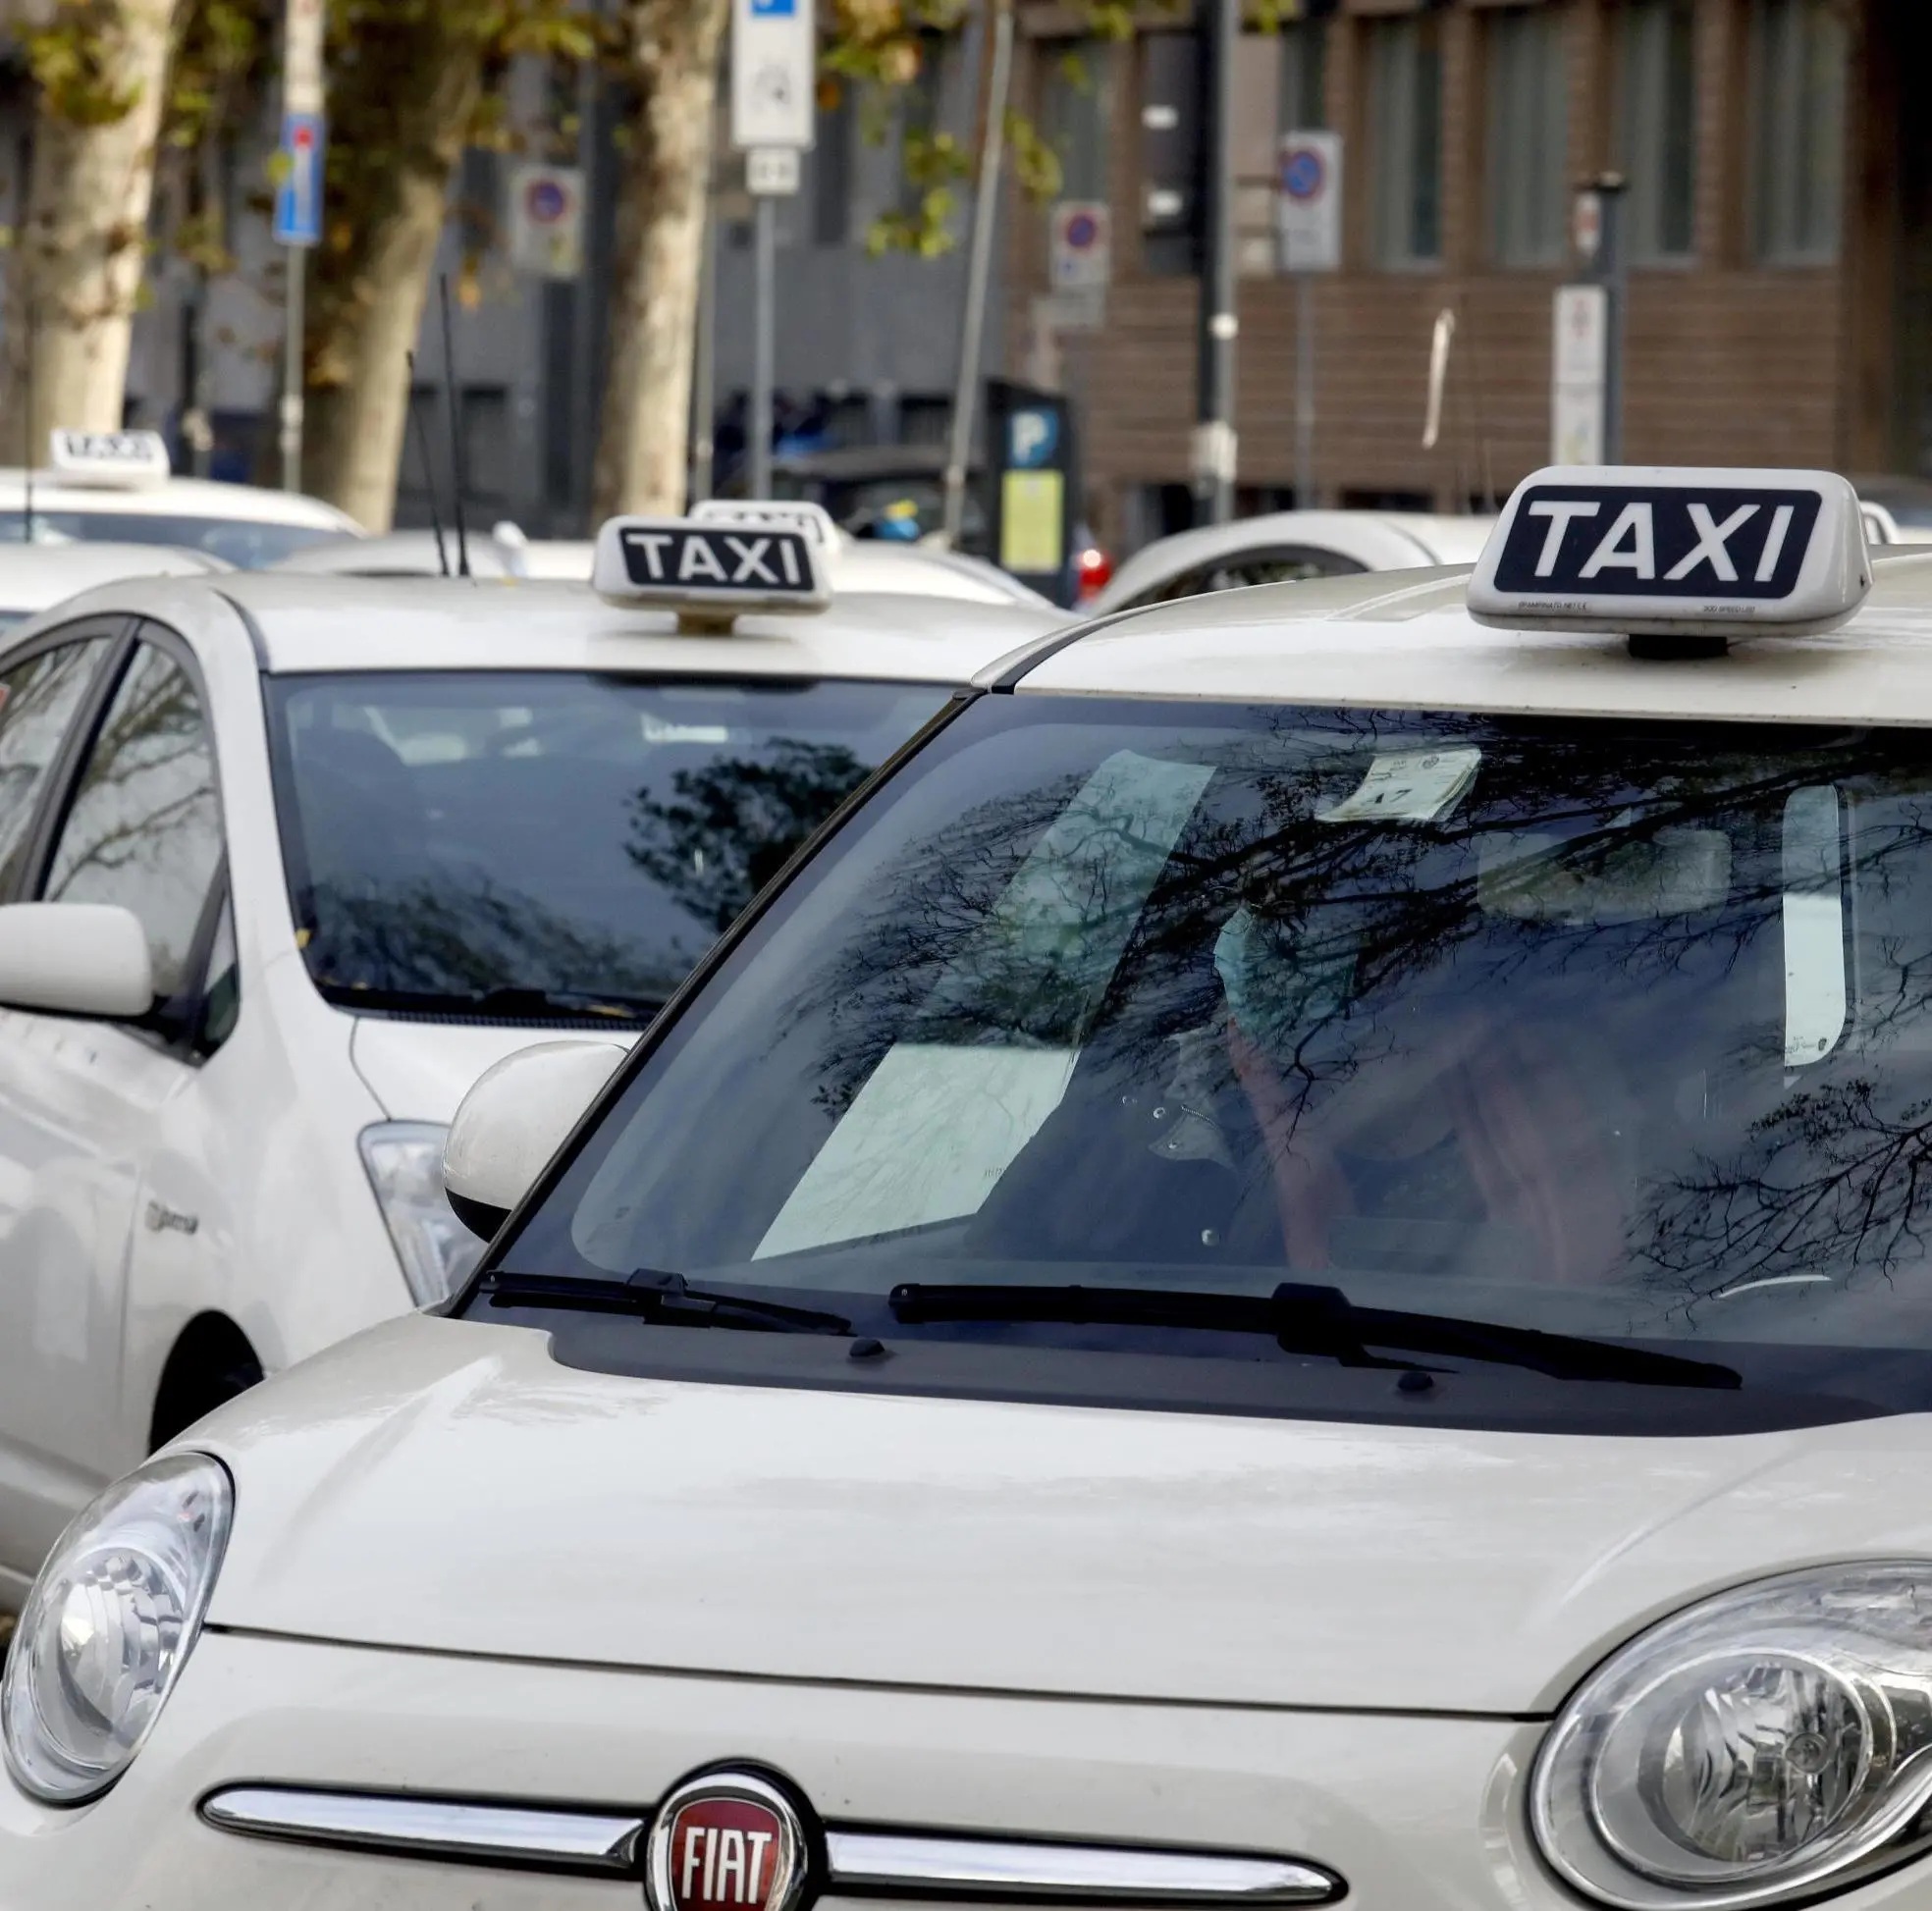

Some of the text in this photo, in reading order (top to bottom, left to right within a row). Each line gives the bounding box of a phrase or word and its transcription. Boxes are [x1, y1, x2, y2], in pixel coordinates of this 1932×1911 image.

[626, 533, 801, 585] TAXI
[1528, 501, 1795, 582] TAXI
[681, 1827, 773, 1904] FIAT
